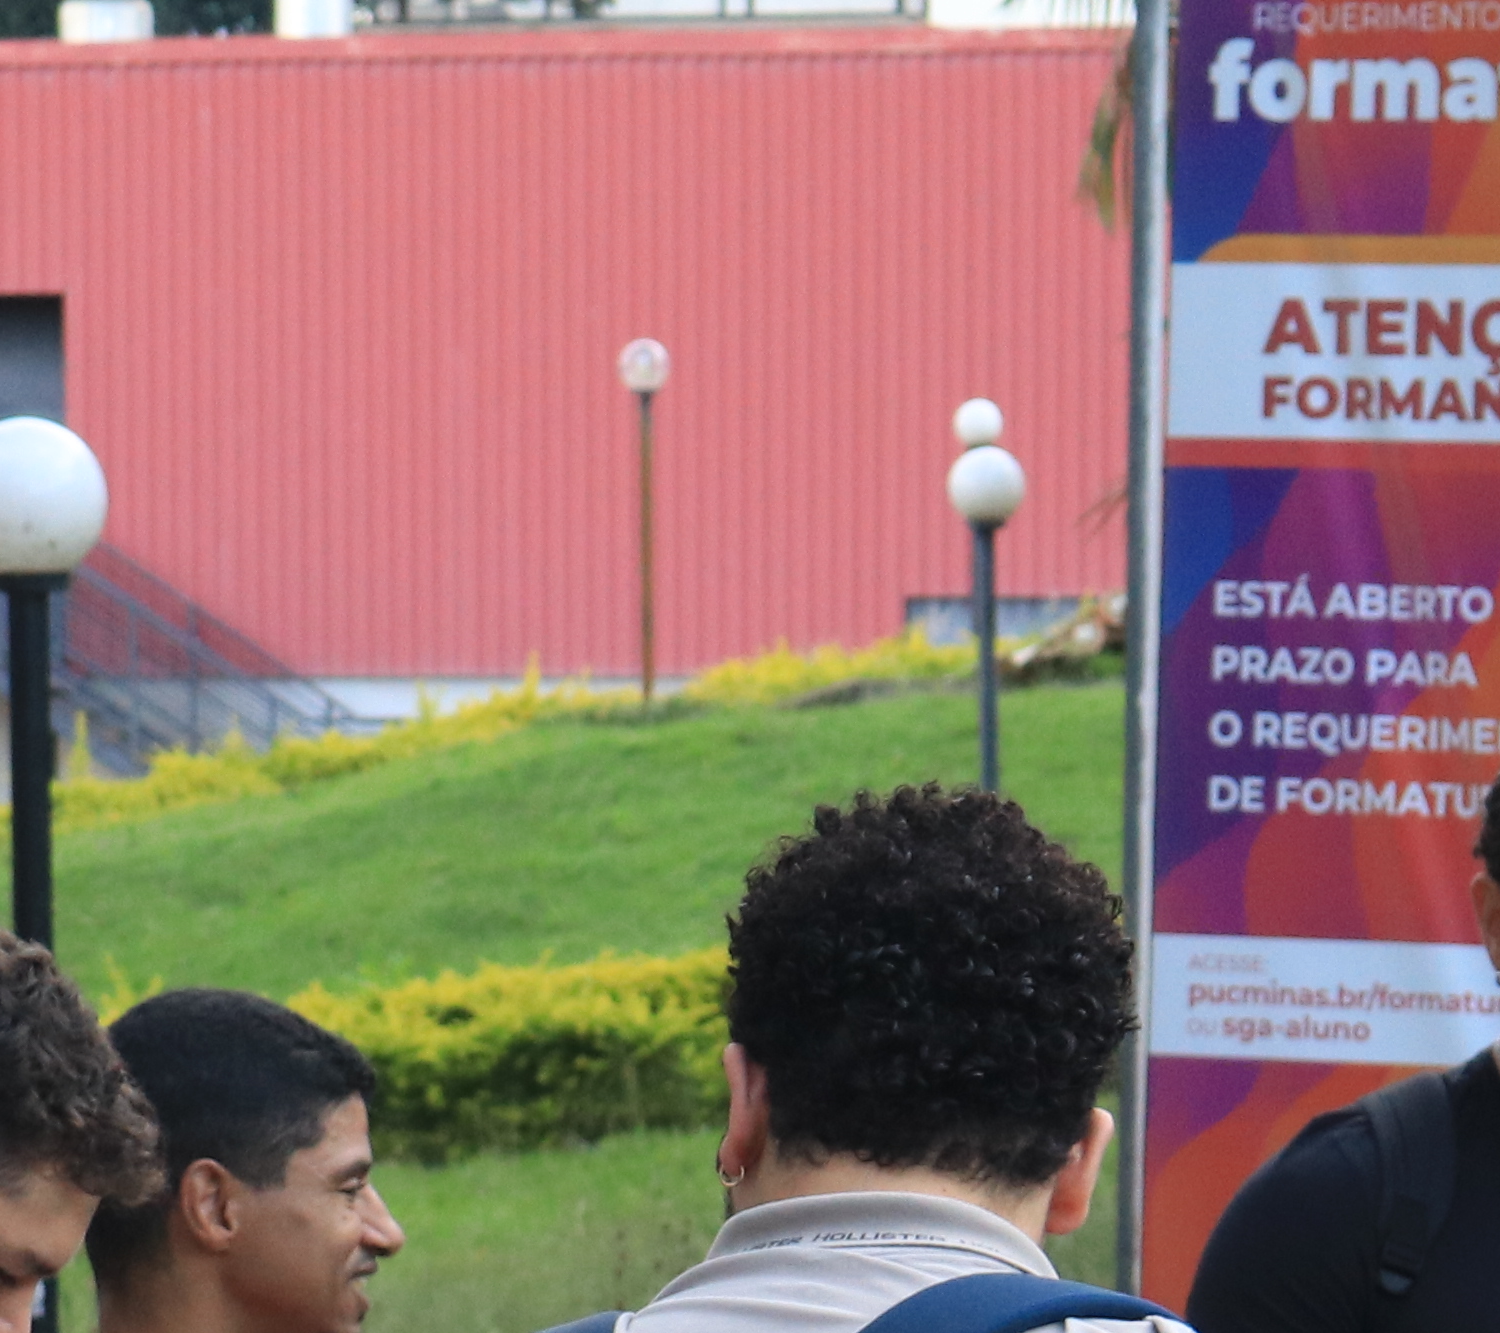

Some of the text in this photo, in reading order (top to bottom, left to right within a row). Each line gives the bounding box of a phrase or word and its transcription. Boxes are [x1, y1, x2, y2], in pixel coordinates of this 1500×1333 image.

[1214, 573, 1316, 619] ESTÁ
[1326, 582, 1493, 624] ABERTO
[1212, 645, 1479, 687] PRAZO PARA
[1209, 710, 1243, 749] O
[1208, 776, 1264, 812] DE
[1222, 1015, 1371, 1042] sga-aluno
